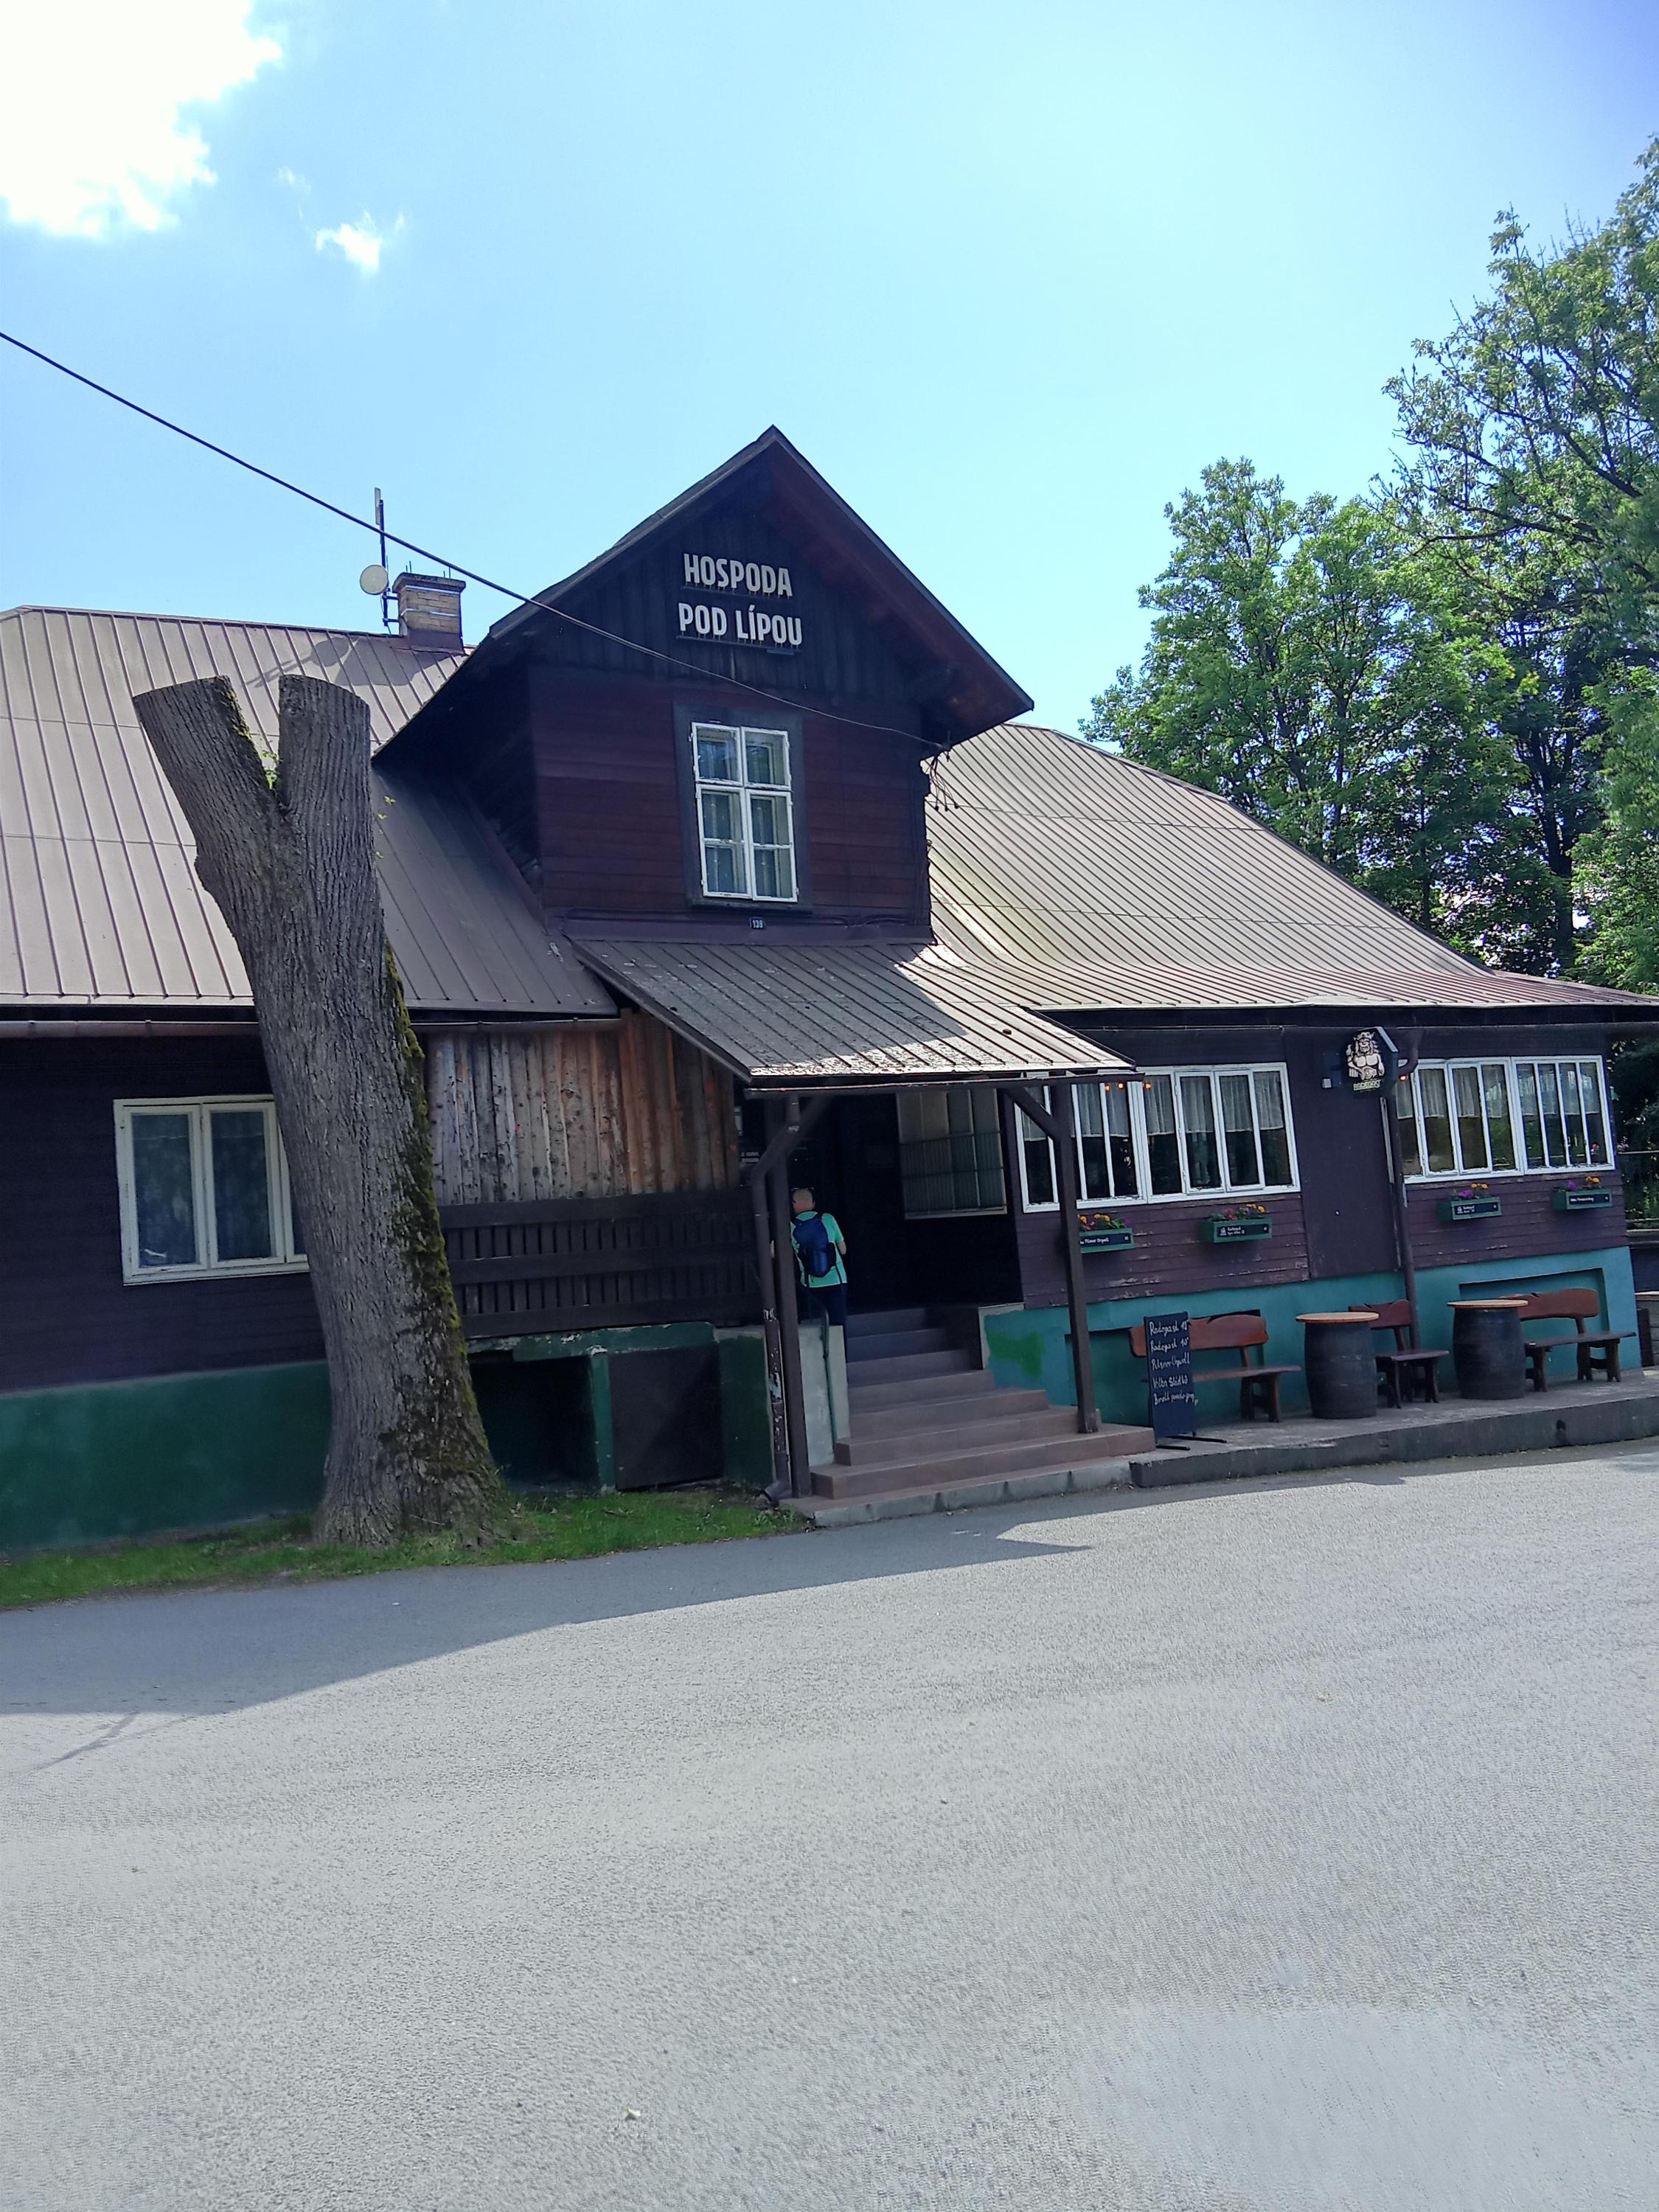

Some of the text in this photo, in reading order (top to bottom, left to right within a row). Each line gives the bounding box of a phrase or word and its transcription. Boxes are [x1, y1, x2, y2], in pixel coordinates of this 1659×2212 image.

[684, 553, 793, 597] HOSPODA
[678, 602, 803, 645] POD LÍPOU
[1353, 1079, 1381, 1091] RADEGAST
